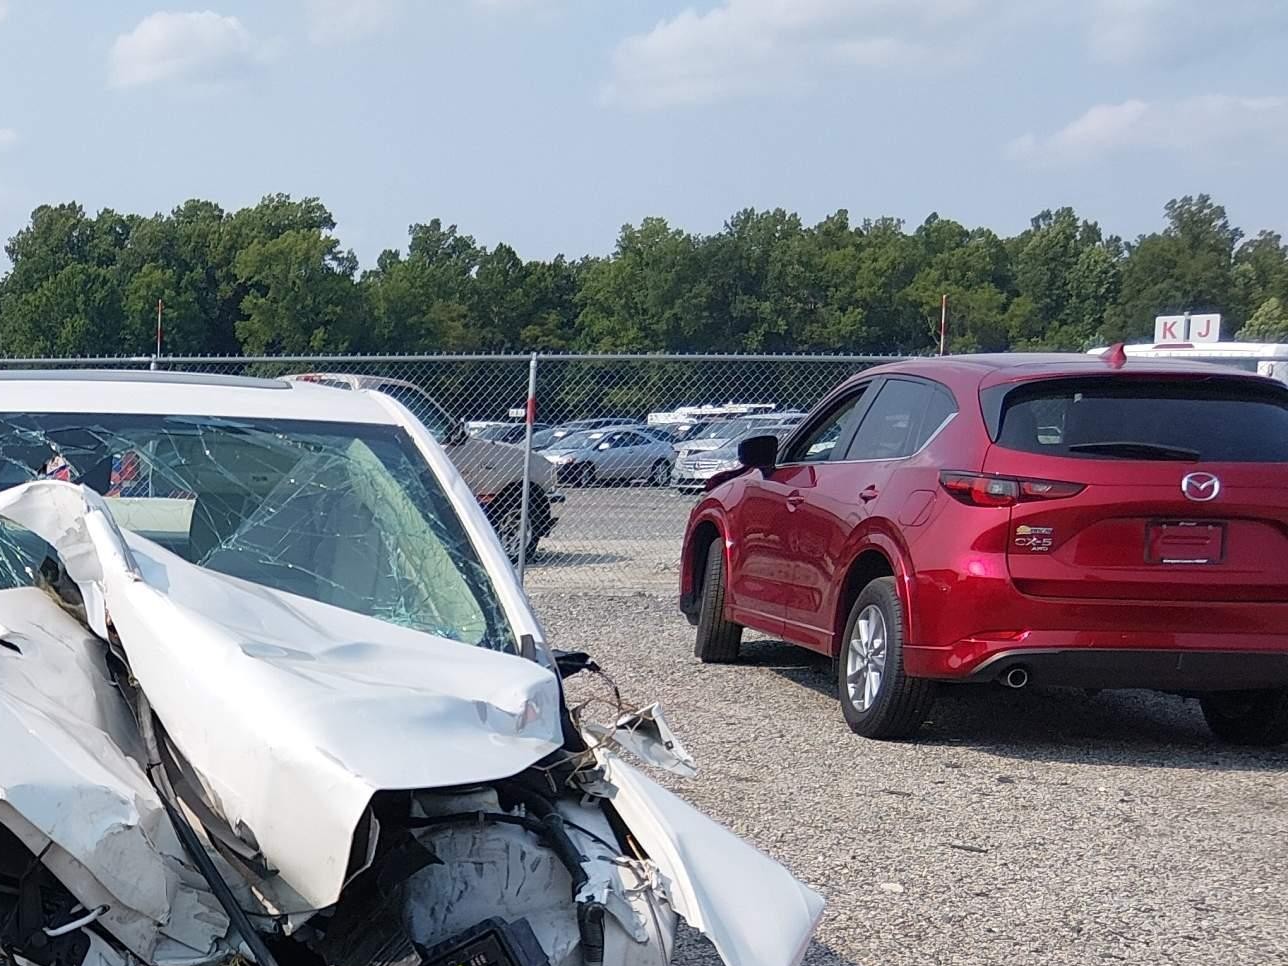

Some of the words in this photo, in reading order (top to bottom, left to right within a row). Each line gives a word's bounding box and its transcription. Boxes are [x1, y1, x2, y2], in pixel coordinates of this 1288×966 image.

[1162, 320, 1178, 340] K
[1197, 319, 1211, 338] J
[1014, 536, 1053, 546] CX-5
